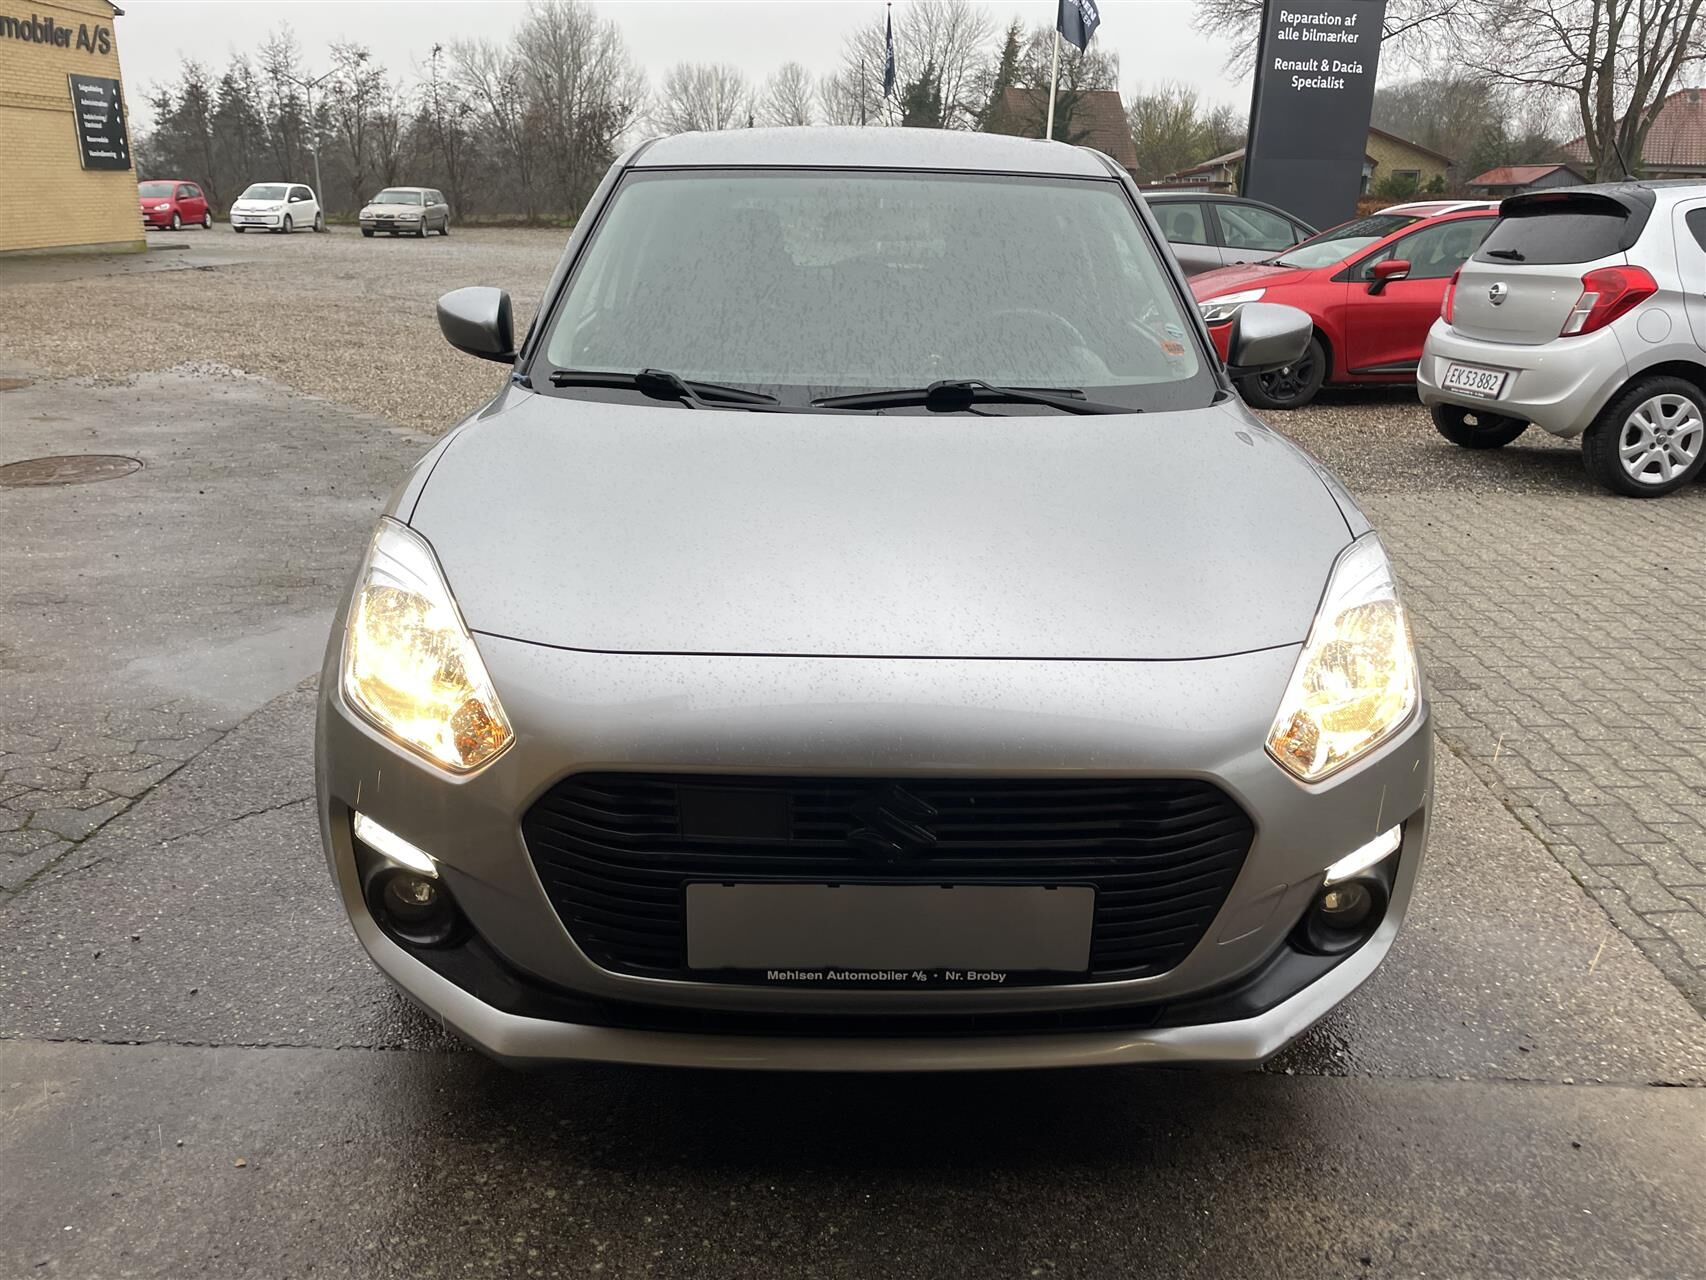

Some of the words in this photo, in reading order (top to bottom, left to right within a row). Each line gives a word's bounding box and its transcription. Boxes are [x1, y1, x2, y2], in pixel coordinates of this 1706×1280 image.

[1280, 10, 1342, 27] Reparation
[1344, 14, 1357, 26] af
[0, 14, 72, 48] mobiler
[76, 23, 111, 55] A/S
[1278, 27, 1299, 41] alle
[1302, 28, 1359, 43] bilmærker
[1274, 57, 1318, 71] Renault
[1320, 59, 1329, 72] &
[1332, 60, 1363, 74] Dacia
[1291, 75, 1344, 91] Specialist
[767, 970, 822, 981] Mehlsen
[827, 970, 909, 982] Automobiler
[945, 971, 964, 981] Nr.
[967, 971, 1007, 983] Broby
